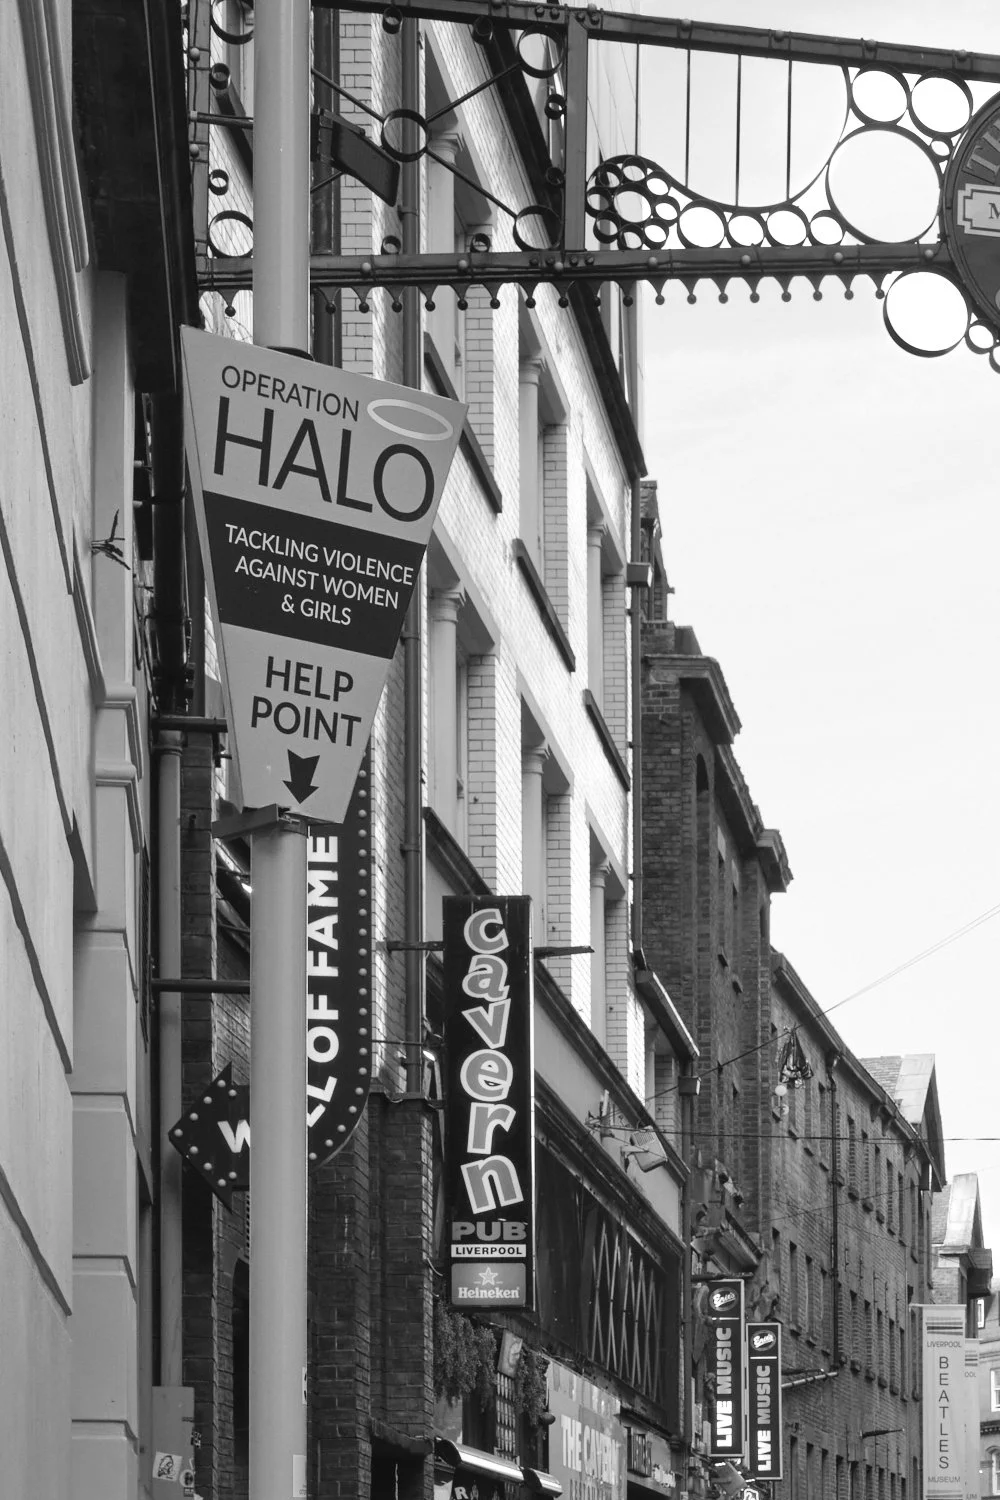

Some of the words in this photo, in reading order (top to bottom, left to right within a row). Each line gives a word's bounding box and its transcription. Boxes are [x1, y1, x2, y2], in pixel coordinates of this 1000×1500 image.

[221, 365, 359, 422] OPERATION
[213, 397, 435, 522] HALO
[224, 524, 319, 564] TACKLING
[323, 547, 414, 585] VIOLENCE
[234, 556, 319, 590] AGAINST
[323, 575, 399, 610] WOMEN
[281, 595, 295, 614] &
[300, 598, 352, 626] GIRLS
[265, 656, 354, 703] HELP
[250, 695, 362, 748] POINT
[308, 835, 339, 977] FAME
[308, 992, 340, 1063] OF
[460, 908, 524, 1215] cavern
[452, 1221, 527, 1241] PUB
[455, 1246, 522, 1255] LIVERPOOL
[458, 1287, 520, 1299] Heineken
[716, 1327, 732, 1395] MUSIC
[756, 1365, 771, 1425] MUSIC
[938, 1356, 950, 1470] BEATLES
[561, 1414, 582, 1472] THE
[716, 1400, 733, 1448] LIVE
[757, 1430, 772, 1472] LIVE
[927, 1476, 961, 1484] MUSEUM
